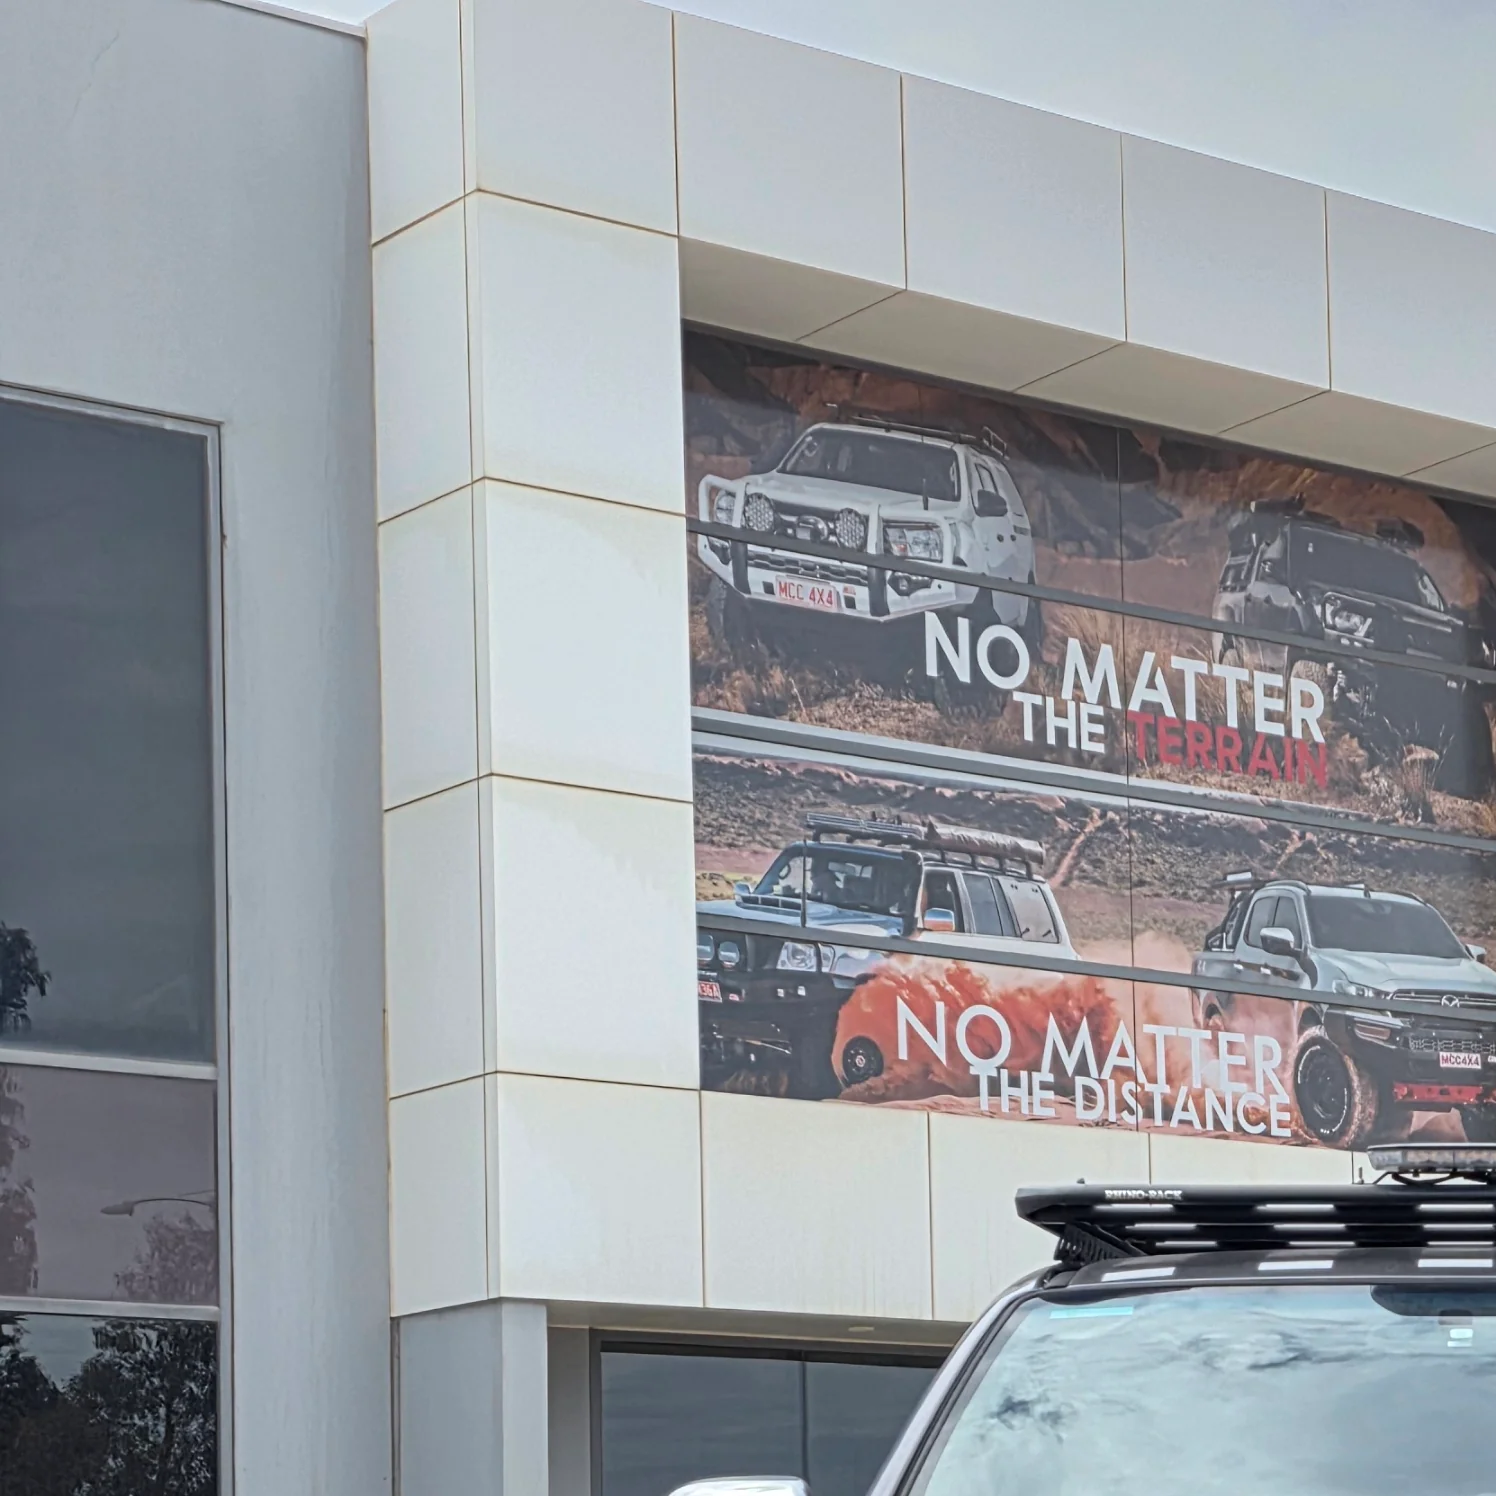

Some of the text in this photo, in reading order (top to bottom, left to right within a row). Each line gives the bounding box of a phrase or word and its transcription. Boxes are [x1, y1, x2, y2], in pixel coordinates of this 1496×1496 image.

[778, 581, 804, 601] MCC
[809, 586, 834, 608] 4X4
[924, 611, 1325, 743] NO MATTER
[1013, 691, 1328, 789] THE TERRAIN
[896, 996, 1285, 1097] NO MATTER
[970, 1065, 1292, 1138] THE DISTANCE
[1104, 1189, 1183, 1201] RHINO-RACK
